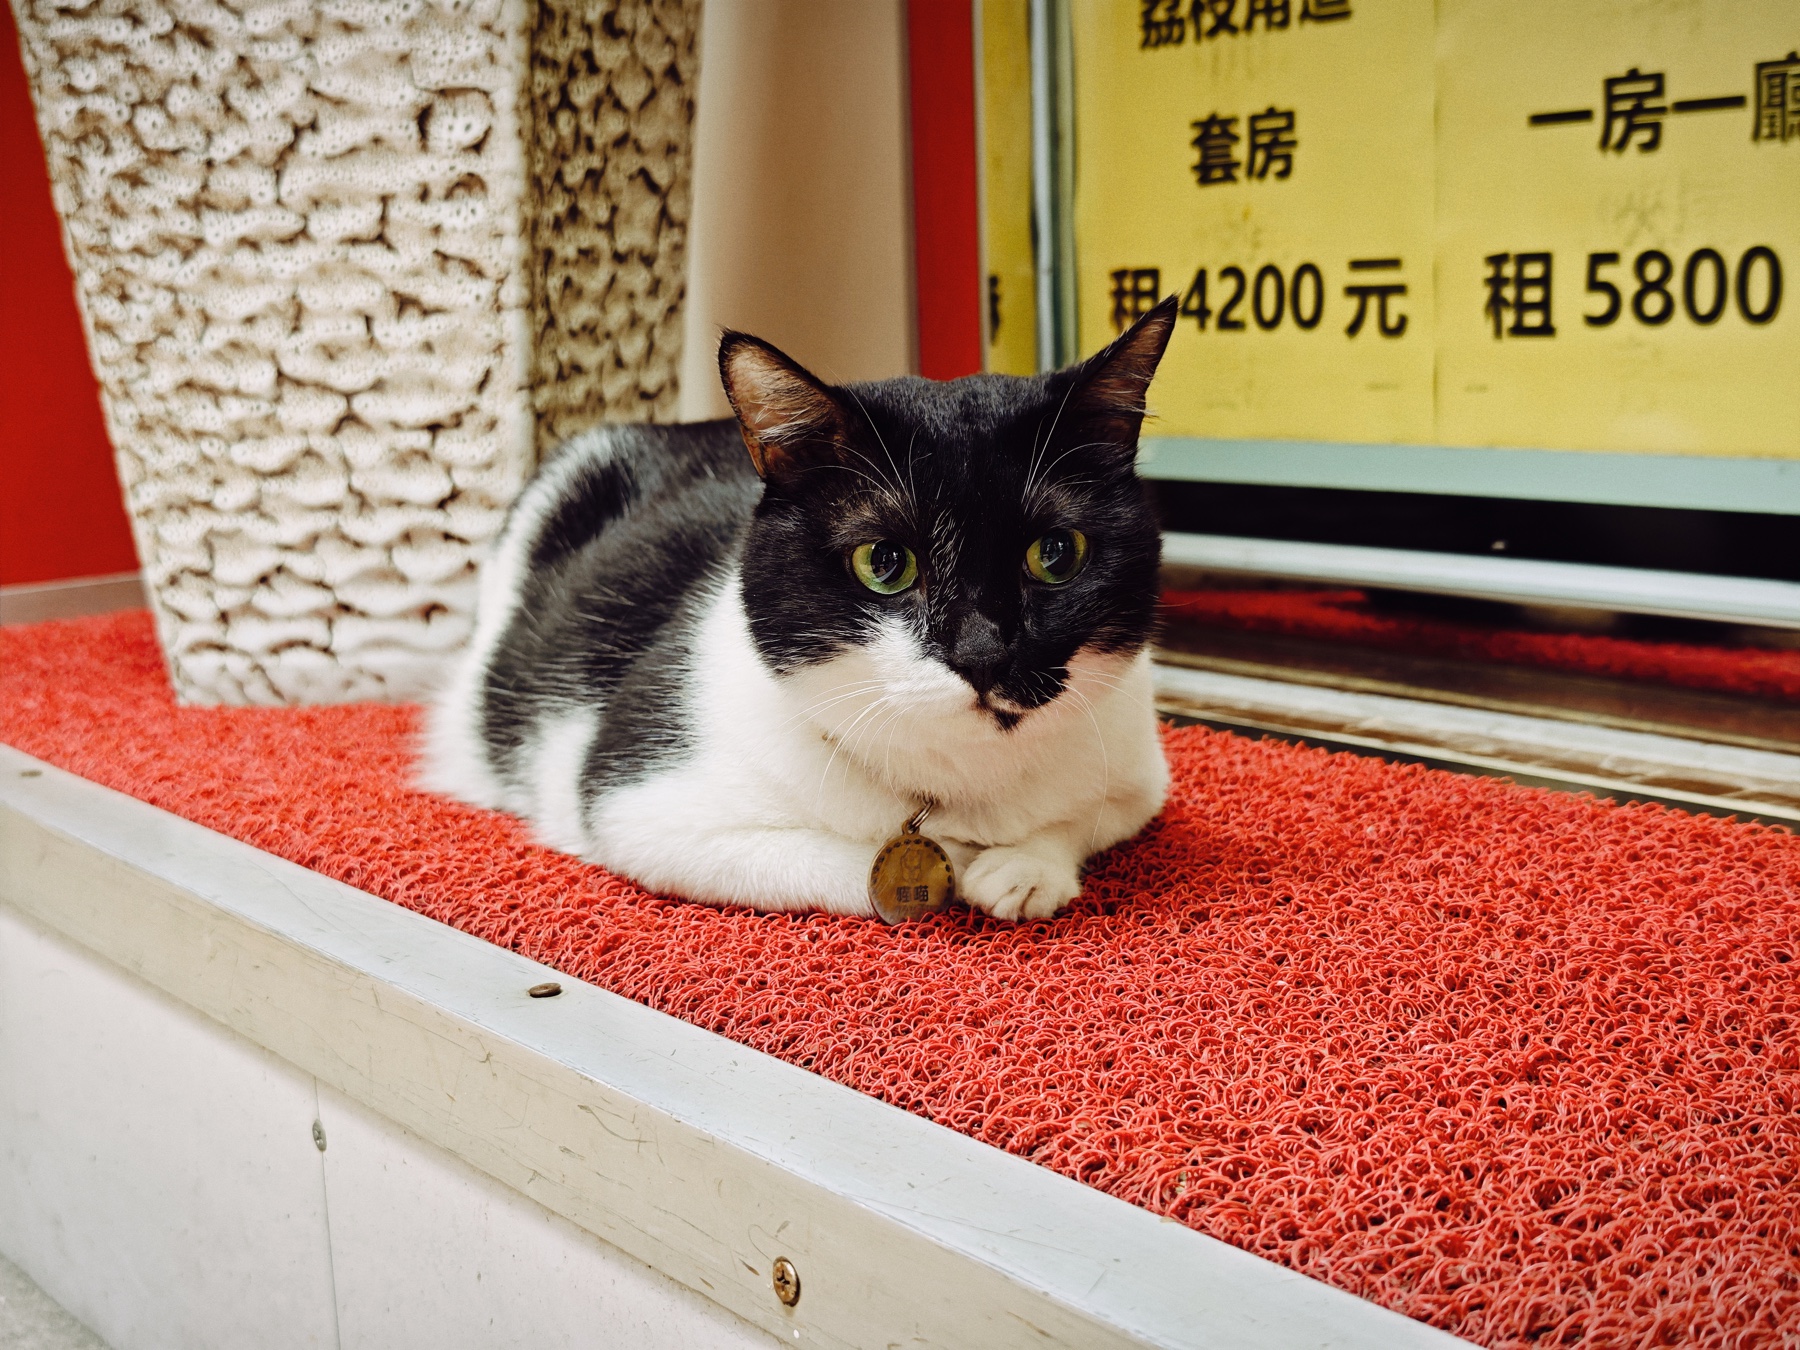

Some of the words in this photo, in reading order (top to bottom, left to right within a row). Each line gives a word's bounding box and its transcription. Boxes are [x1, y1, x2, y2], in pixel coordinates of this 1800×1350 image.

[1528, 50, 1800, 154] 一房一廳
[1190, 106, 1298, 188] 套房
[1179, 262, 1325, 332] 4200
[1344, 258, 1408, 338] 元
[1484, 251, 1556, 338] 租
[1584, 245, 1784, 328] 5800
